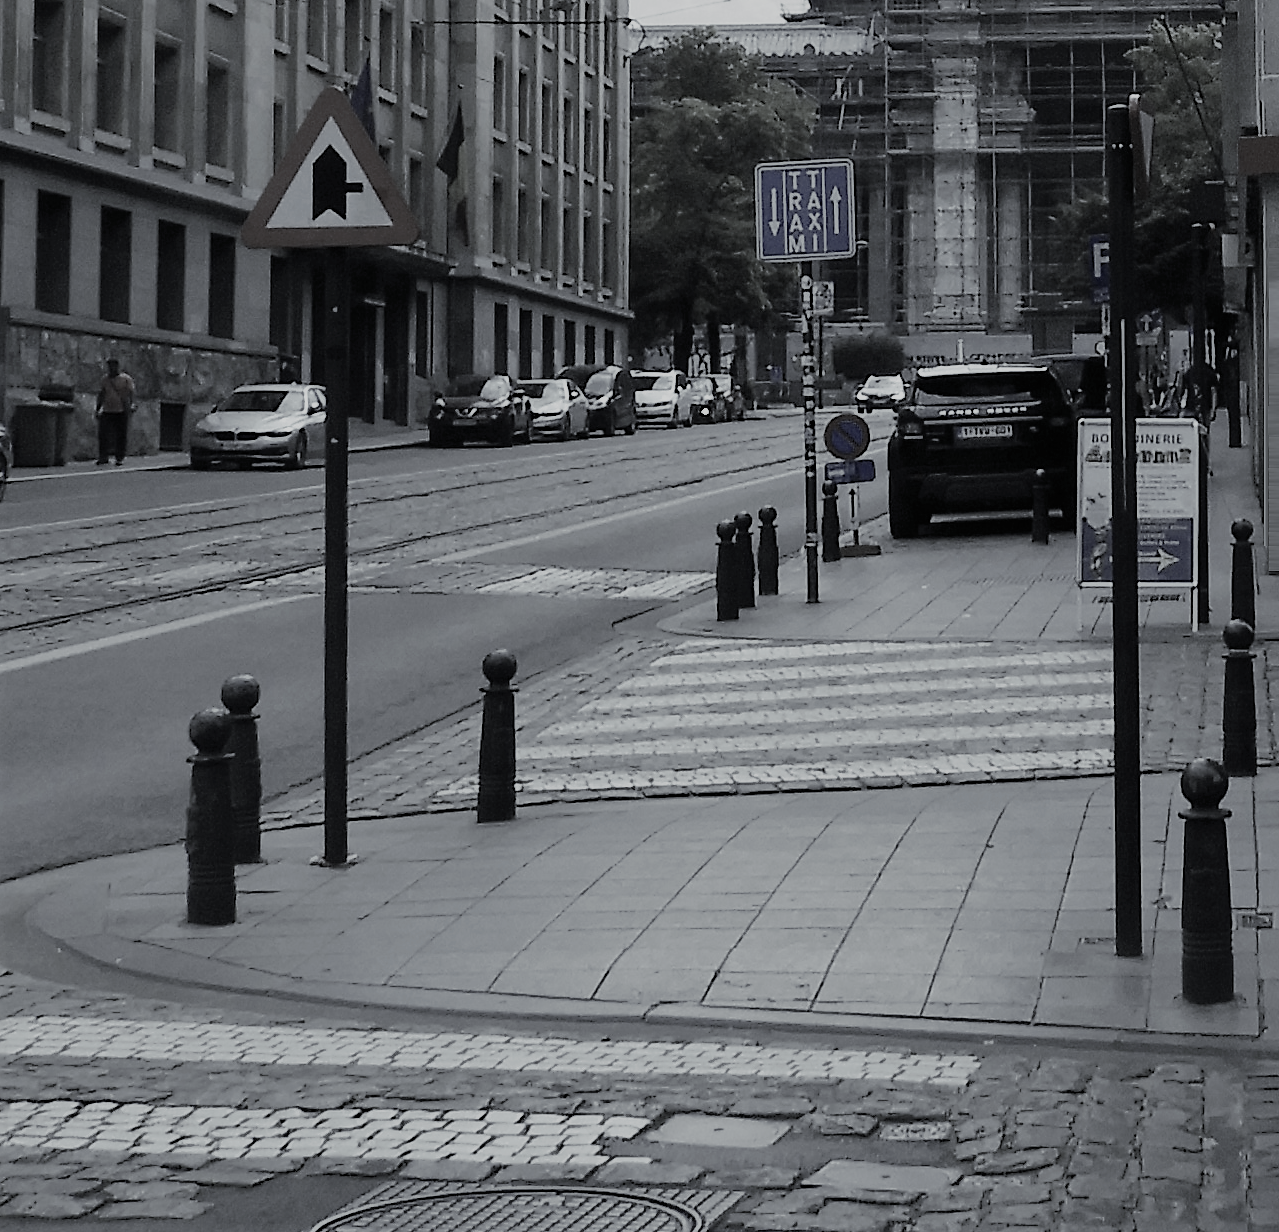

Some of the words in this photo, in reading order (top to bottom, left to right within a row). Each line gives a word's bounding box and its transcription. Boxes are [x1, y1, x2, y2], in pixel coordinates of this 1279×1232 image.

[788, 170, 806, 253] TRAM
[806, 169, 821, 252] TAXI
[1092, 433, 1183, 444] BOINERIE
